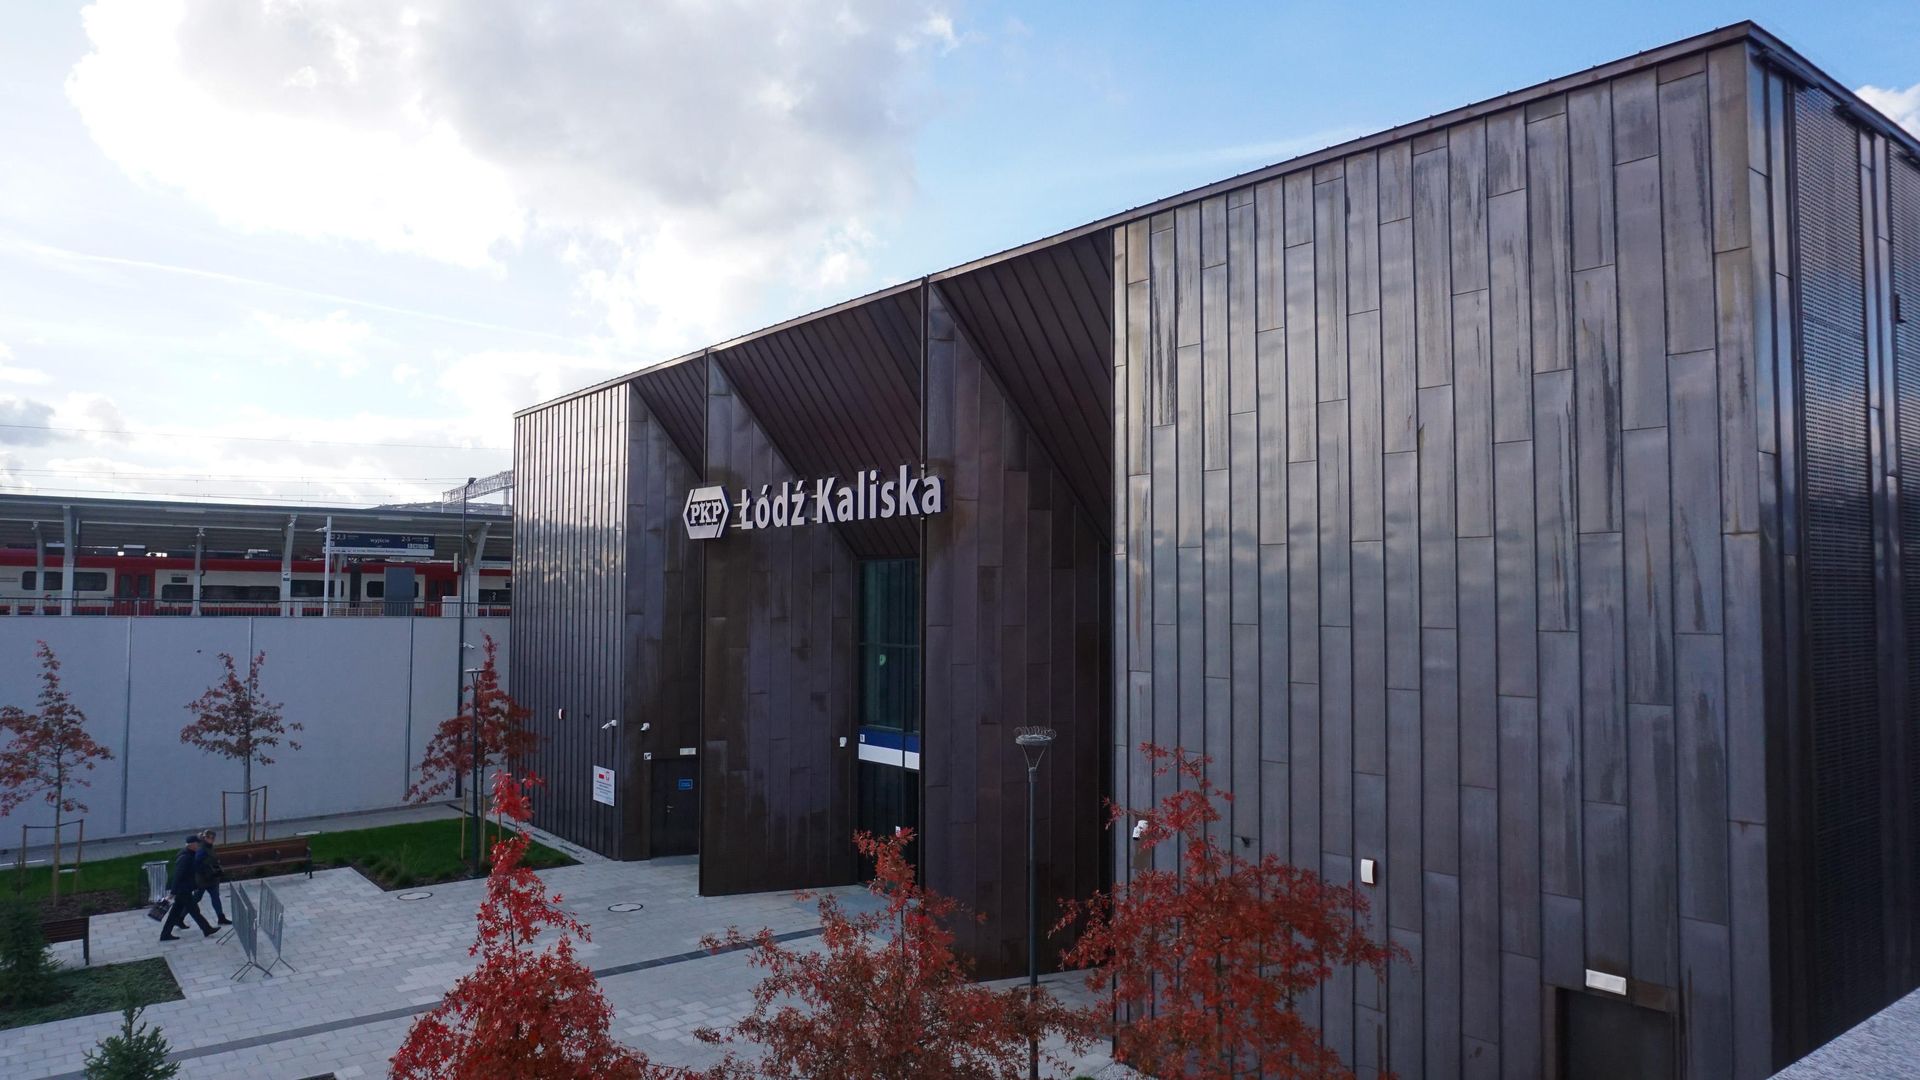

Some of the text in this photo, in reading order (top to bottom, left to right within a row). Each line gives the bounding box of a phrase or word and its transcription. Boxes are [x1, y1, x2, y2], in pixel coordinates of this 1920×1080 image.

[690, 501, 722, 524] PKP
[740, 464, 942, 530] Łódź Kaliska
